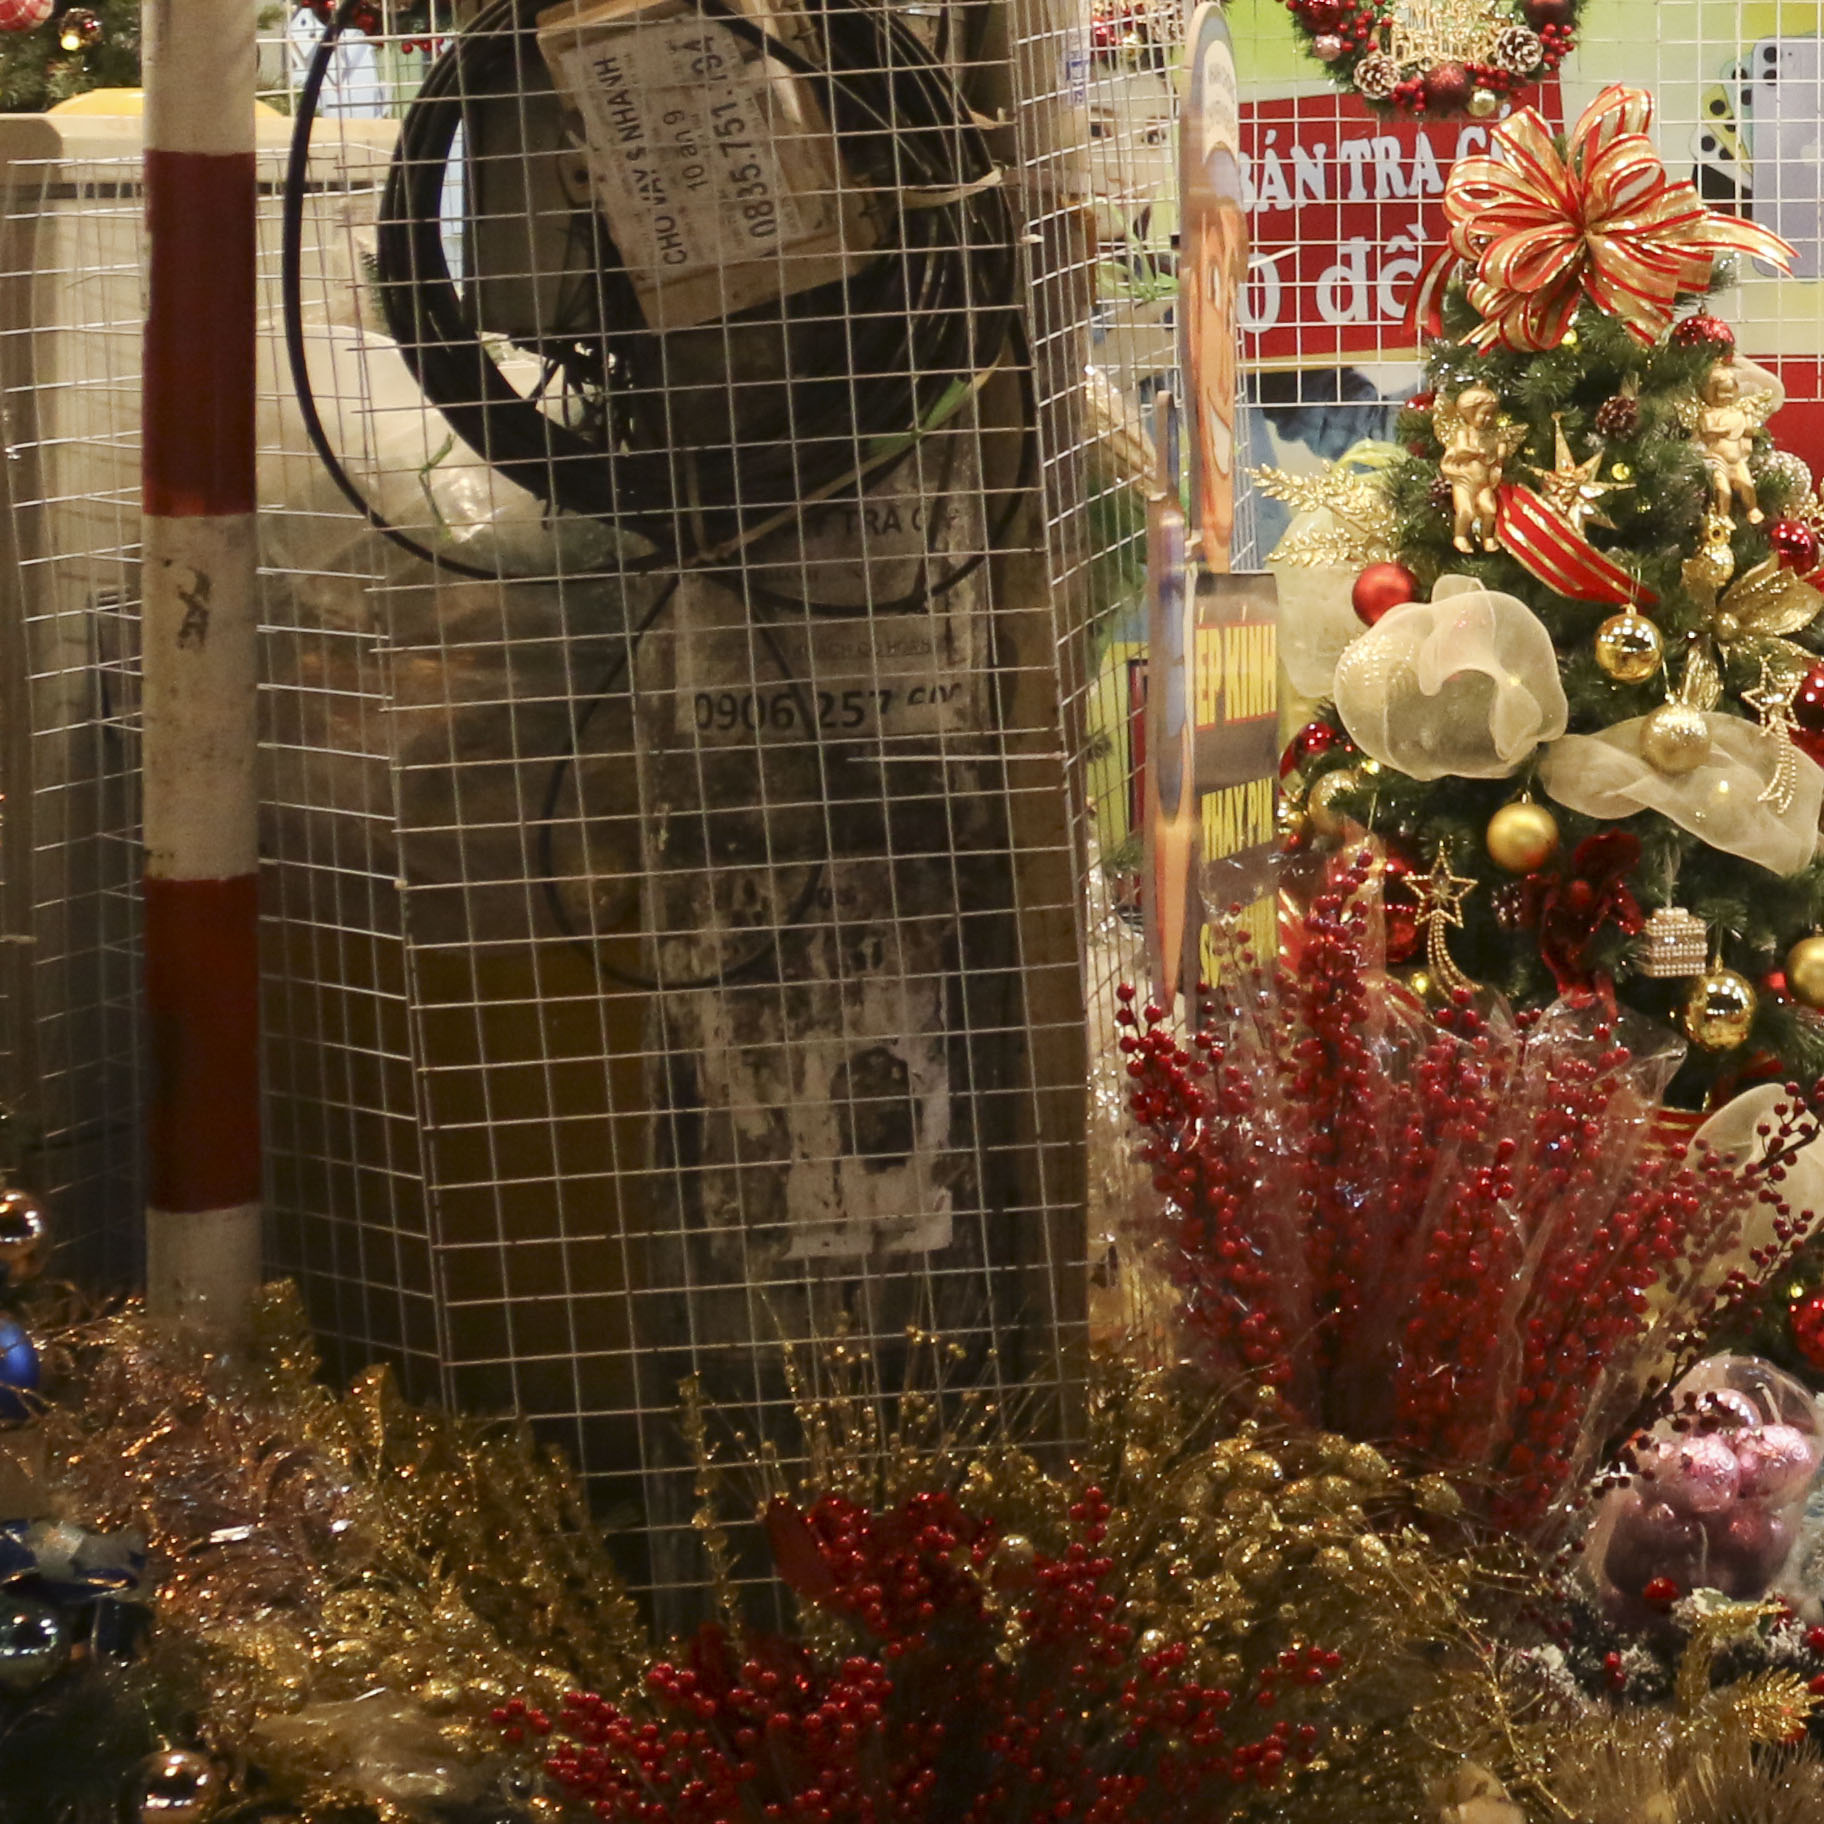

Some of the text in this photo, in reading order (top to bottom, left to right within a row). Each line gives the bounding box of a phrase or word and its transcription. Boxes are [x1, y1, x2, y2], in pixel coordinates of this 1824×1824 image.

[663, 110, 686, 127] 9
[686, 164, 706, 192] 10
[692, 690, 795, 733] 0906
